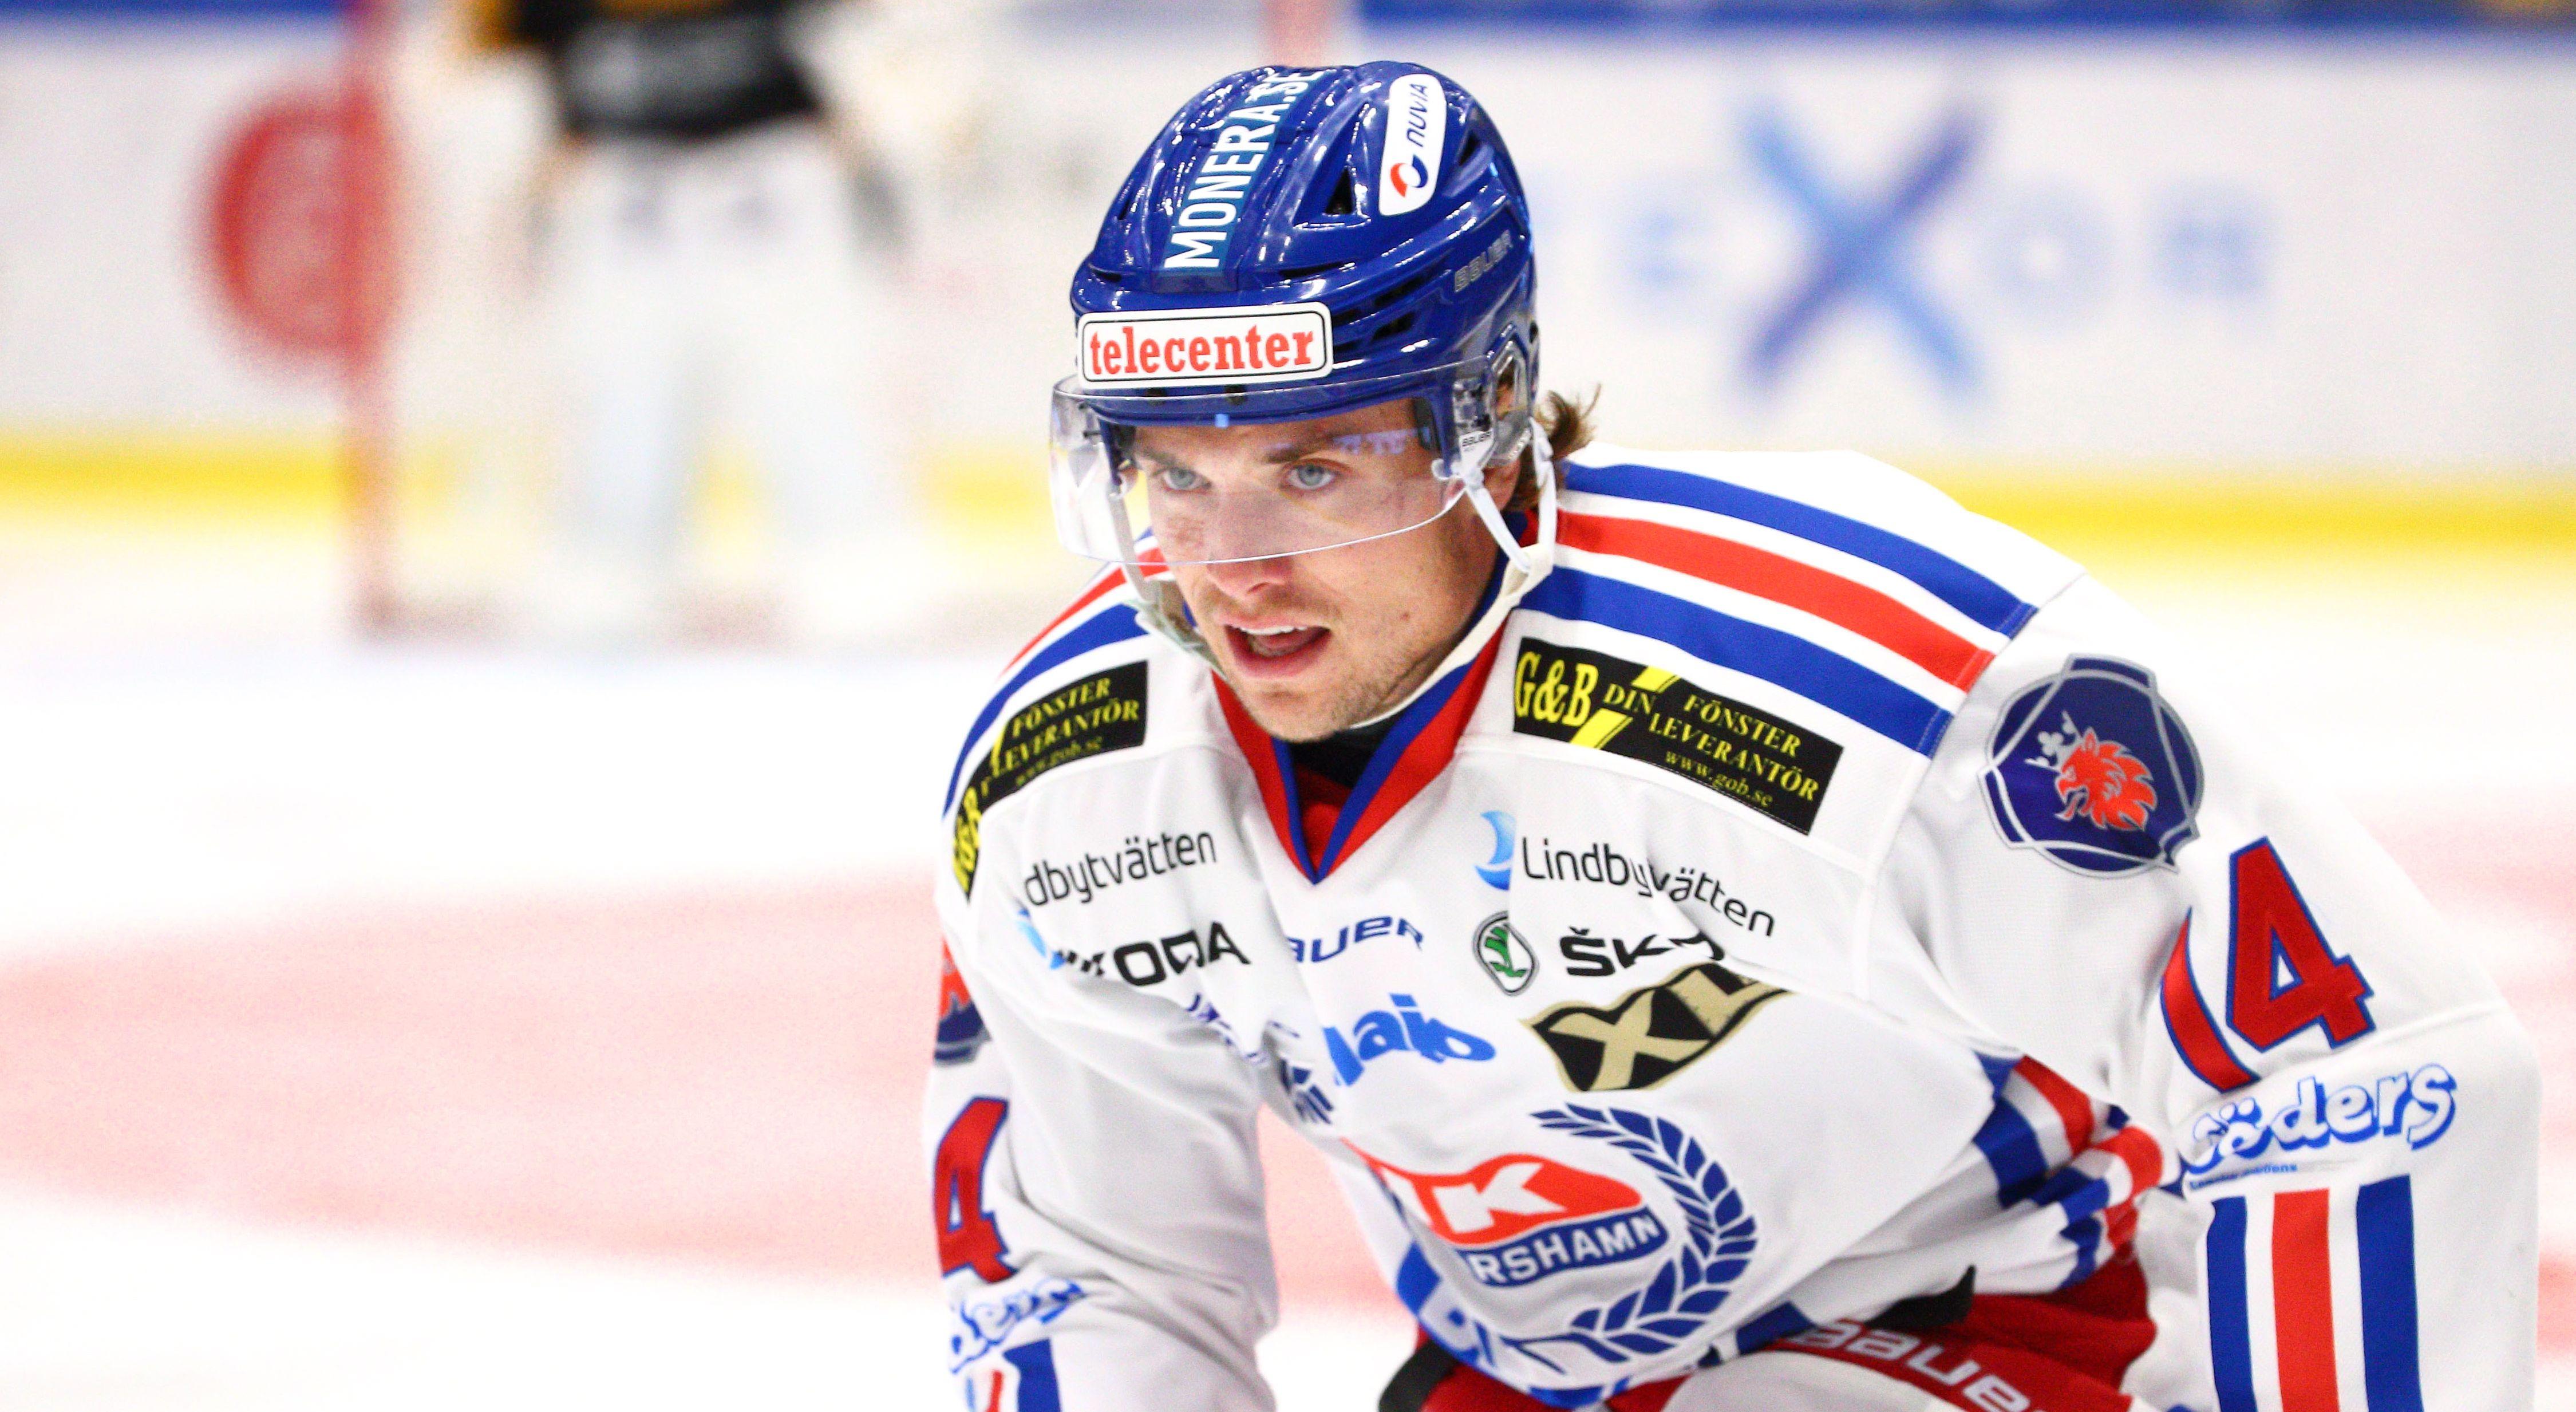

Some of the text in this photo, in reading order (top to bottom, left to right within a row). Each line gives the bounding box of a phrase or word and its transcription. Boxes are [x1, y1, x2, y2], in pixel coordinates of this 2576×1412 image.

[1090, 325, 1314, 376] telecenter
[1514, 651, 1599, 728] G&B
[1603, 683, 1659, 716] DIN
[1684, 692, 1802, 759] FÖNSTER
[1649, 712, 1819, 803] LEVERANTÖR
[1664, 751, 1774, 809] www.gob.se
[1024, 831, 1217, 907] dbytvätten
[1286, 915, 1424, 963] AUER
[1547, 969, 1775, 1090] XL
[933, 1096, 1019, 1284] 4
[1471, 1212, 1660, 1285] RSHAMN
